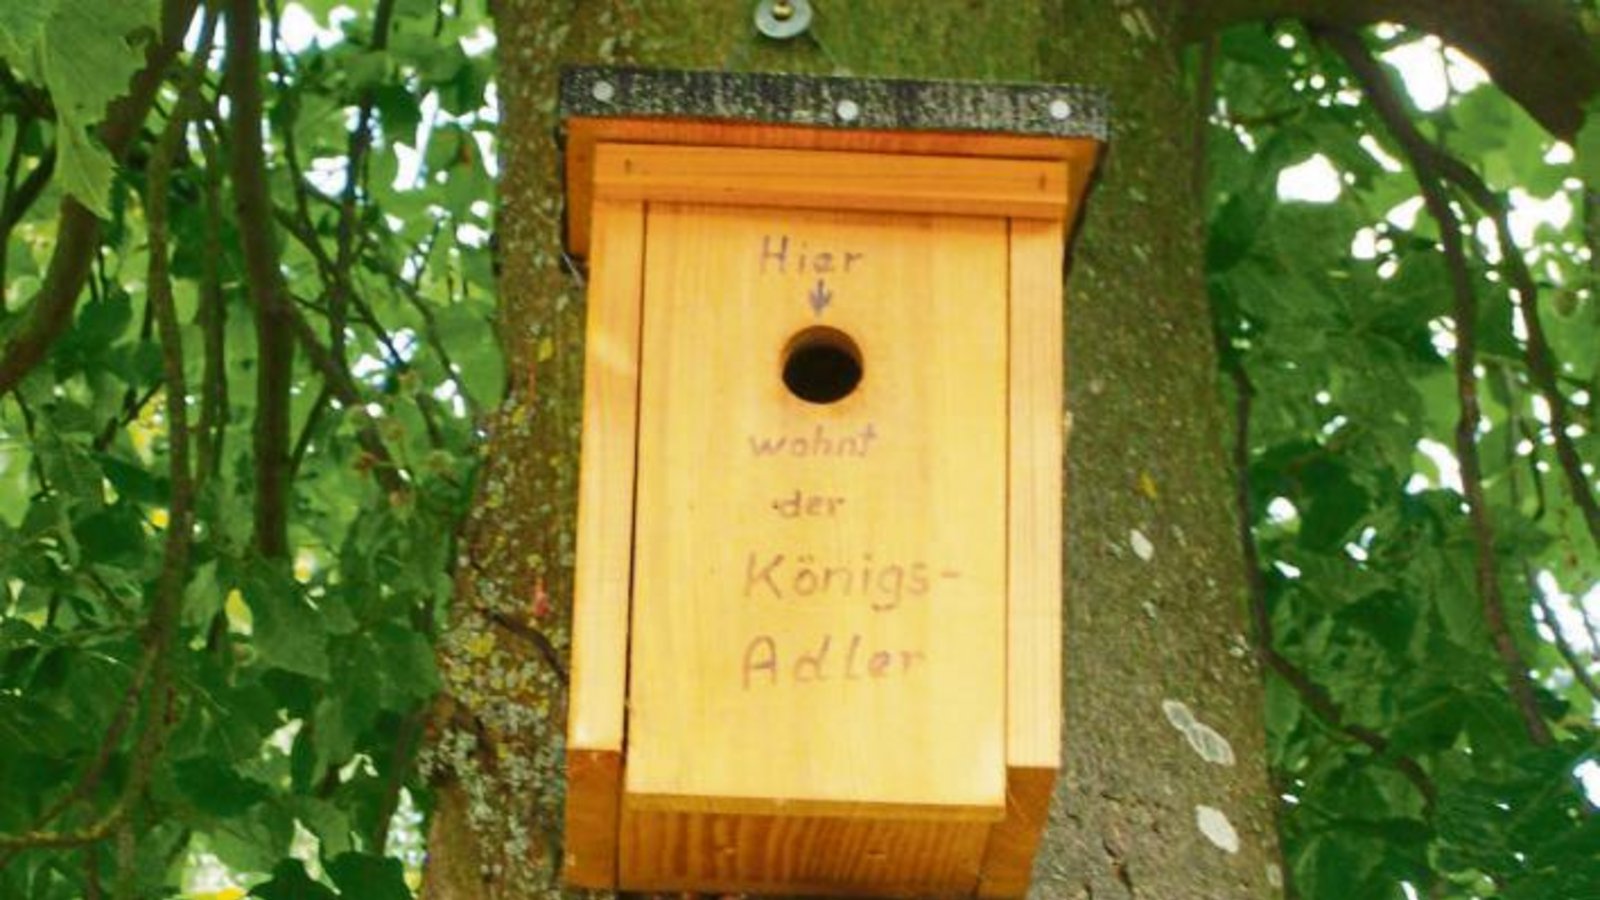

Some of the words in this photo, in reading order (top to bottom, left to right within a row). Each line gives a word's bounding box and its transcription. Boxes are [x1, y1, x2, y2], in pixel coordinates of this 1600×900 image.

[759, 235, 863, 274] Hier
[749, 422, 878, 457] wohnt
[776, 489, 846, 518] der
[744, 552, 961, 611] Königs-
[742, 634, 926, 690] Adler
